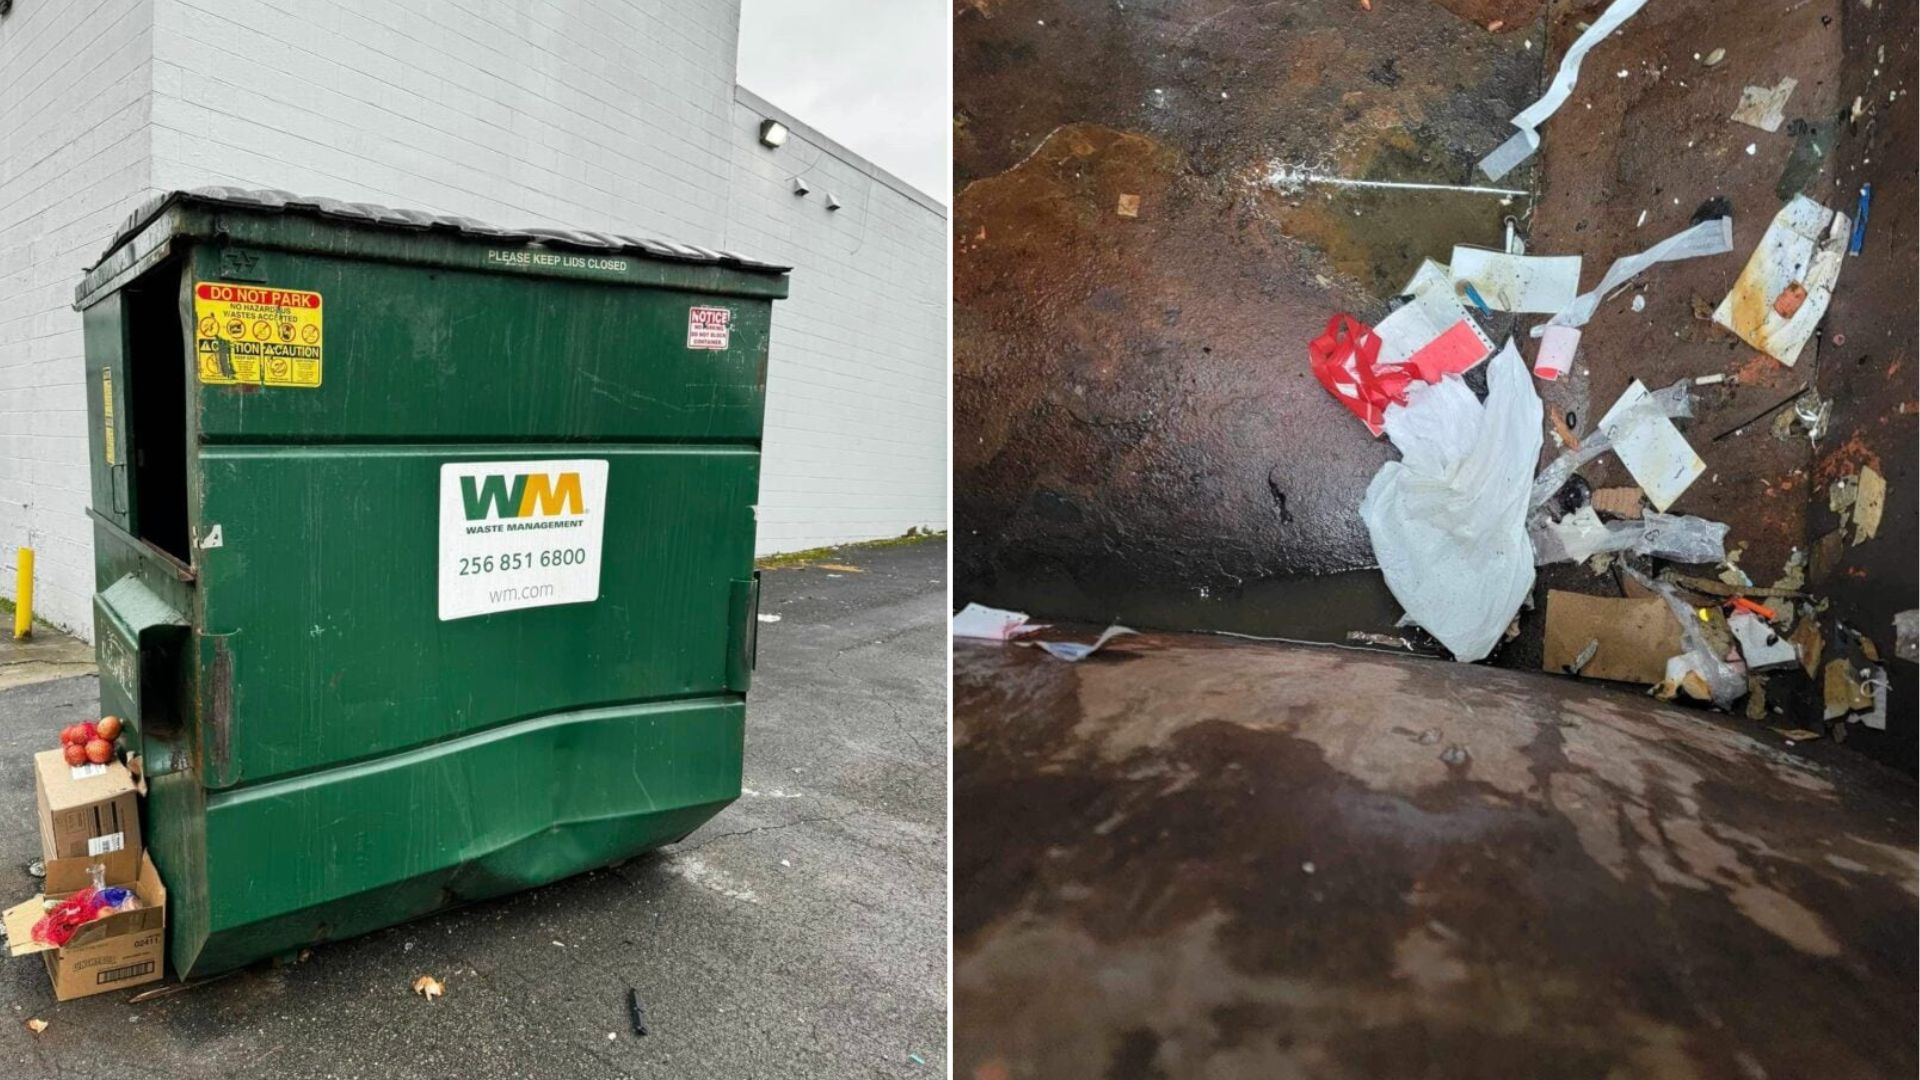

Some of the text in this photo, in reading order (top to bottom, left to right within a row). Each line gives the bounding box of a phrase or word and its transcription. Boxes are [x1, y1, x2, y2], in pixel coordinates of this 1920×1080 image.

[488, 249, 627, 271] PLEASE KEEP LIDS CLOSED
[210, 286, 312, 307] DO NOT PARK
[229, 303, 242, 311] NO
[223, 310, 256, 320] WASTES
[692, 310, 728, 324] NOTICE
[210, 340, 260, 354] CTION
[274, 343, 319, 357] CAUTION
[459, 472, 585, 521] WM
[466, 520, 584, 535] WASTE MANAGEMENT
[459, 548, 586, 576] 256 851 6800
[489, 583, 554, 604] wm.com
